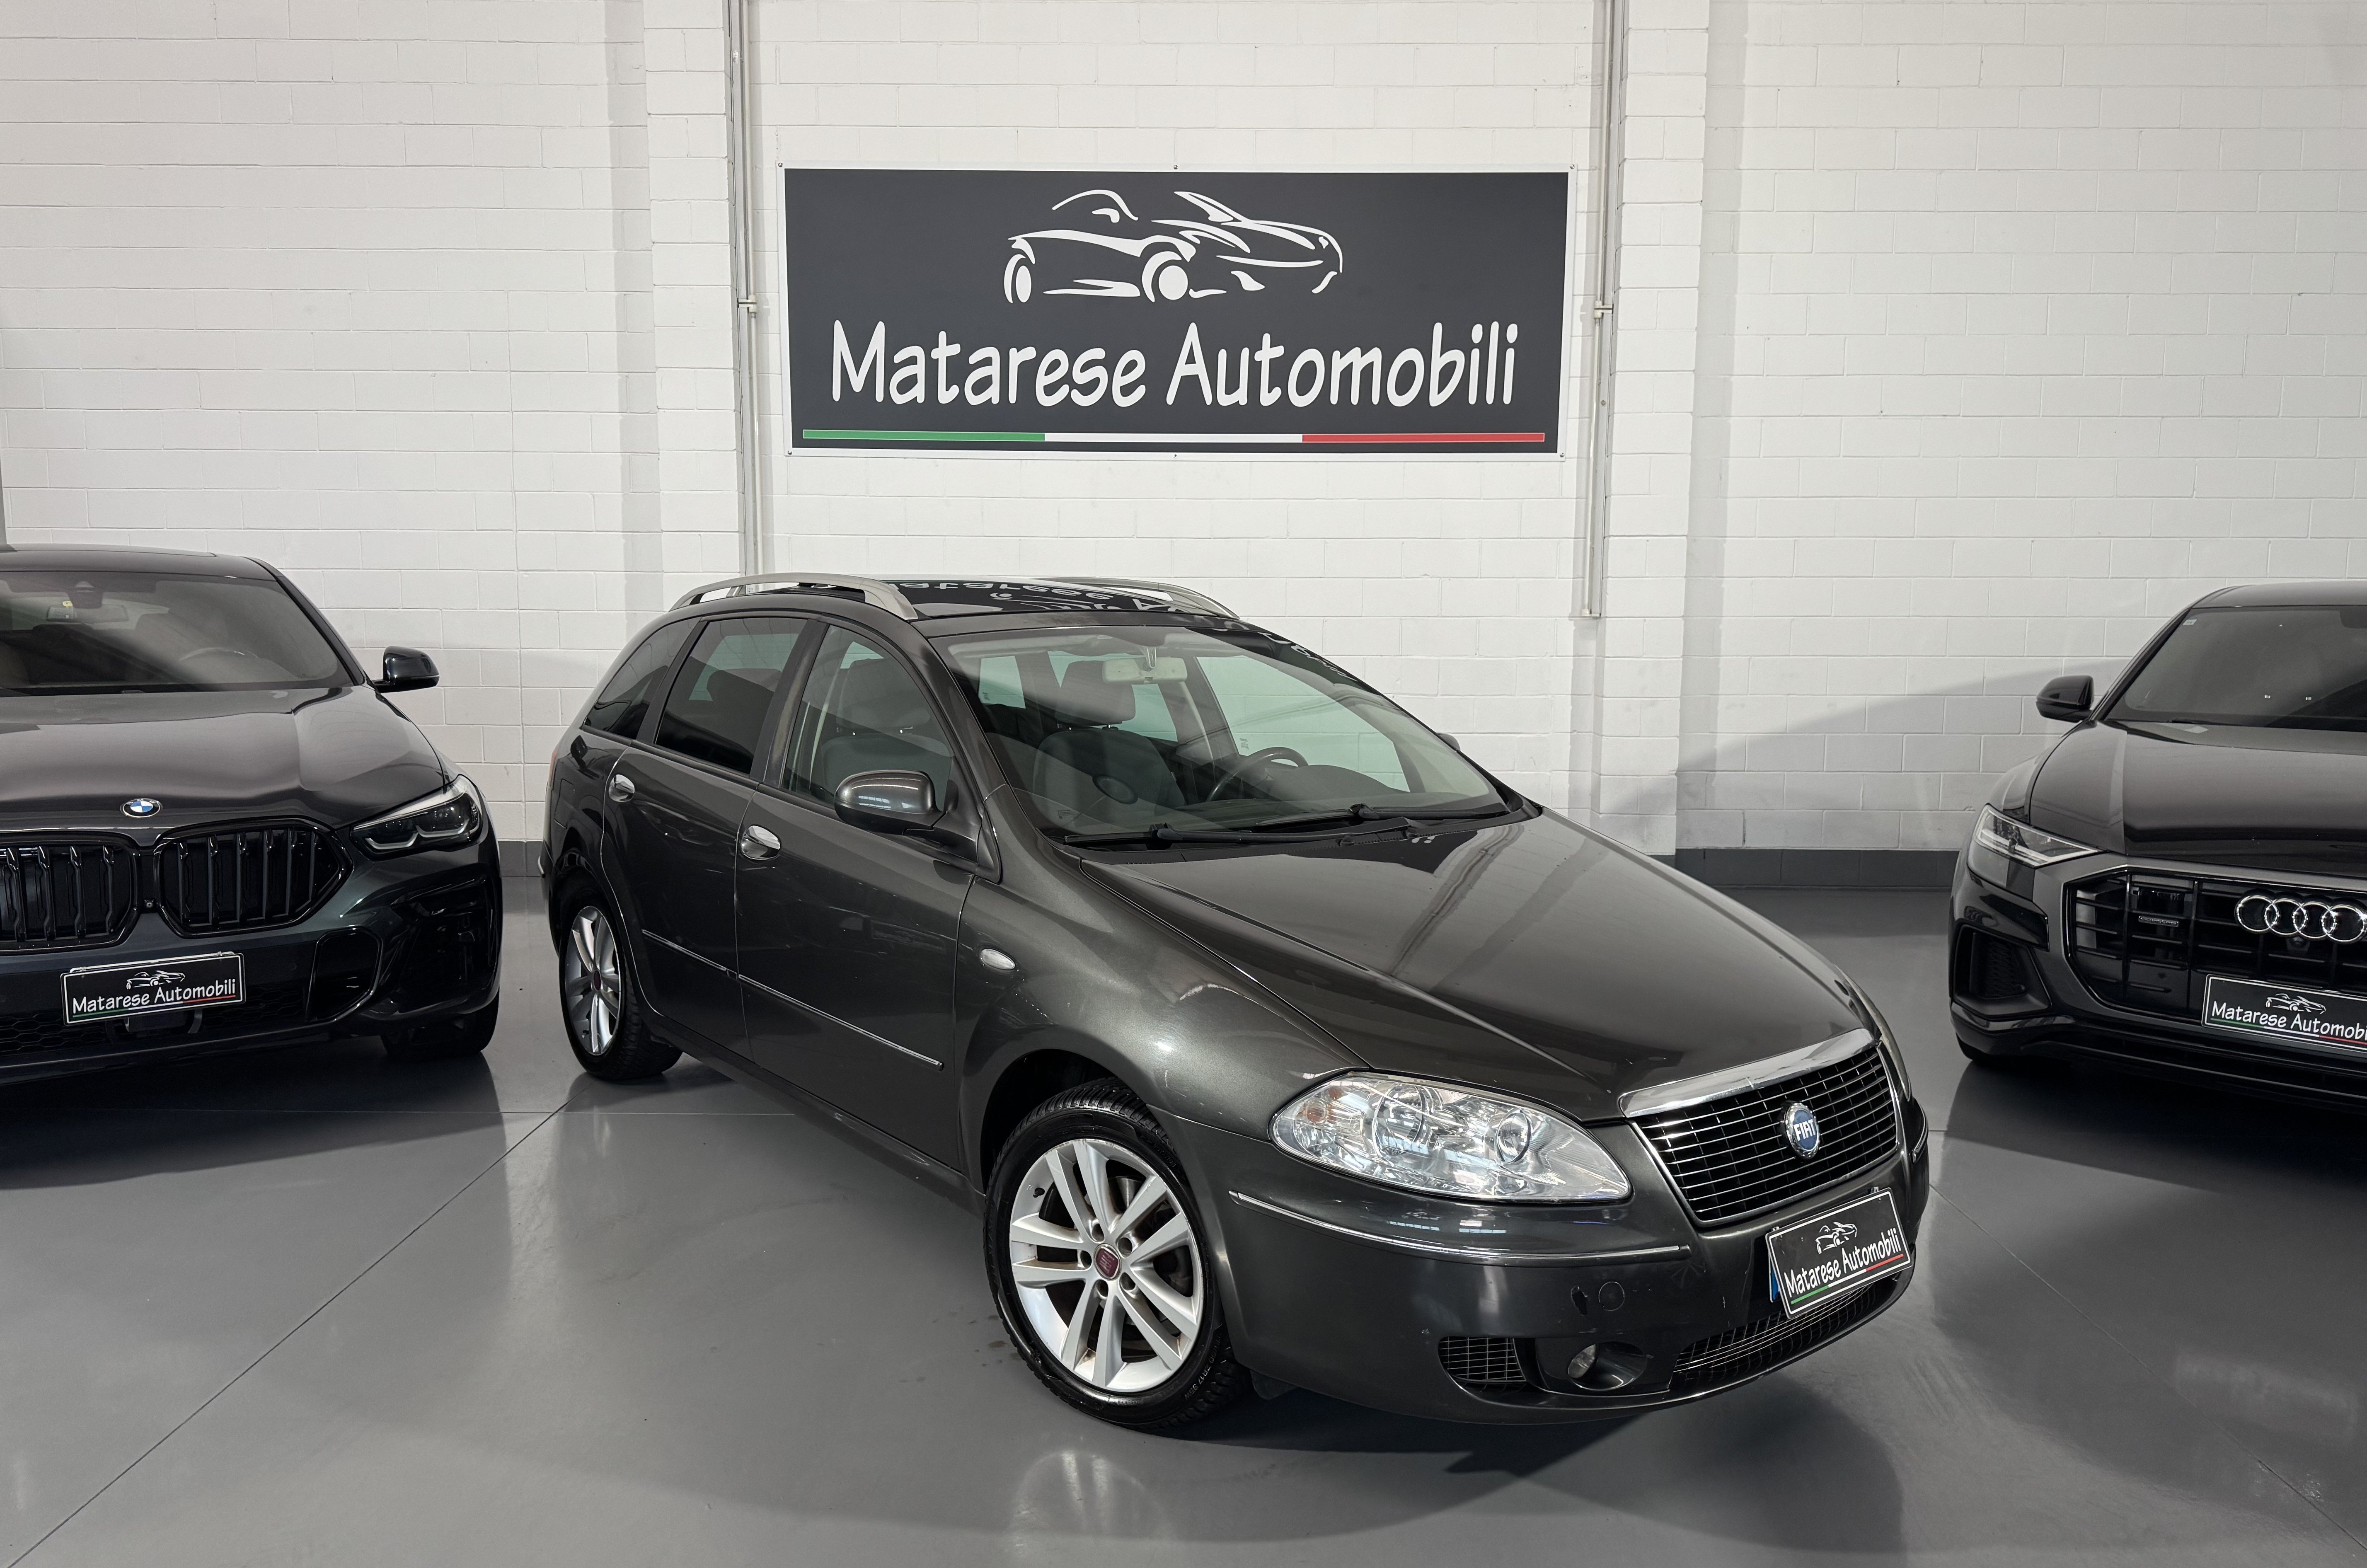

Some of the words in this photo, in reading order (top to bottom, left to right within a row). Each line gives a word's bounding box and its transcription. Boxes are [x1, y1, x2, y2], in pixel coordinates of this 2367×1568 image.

[832, 320, 1146, 407] Matarese
[1166, 321, 1518, 407] Automobili
[73, 993, 150, 1014] Matarese
[154, 978, 236, 1004] Automobili
[2212, 1001, 2287, 1028] Matarese
[1793, 1118, 1815, 1142] FIAT
[1784, 1259, 1841, 1298] Matarese
[1842, 1228, 1902, 1274] Automobili
